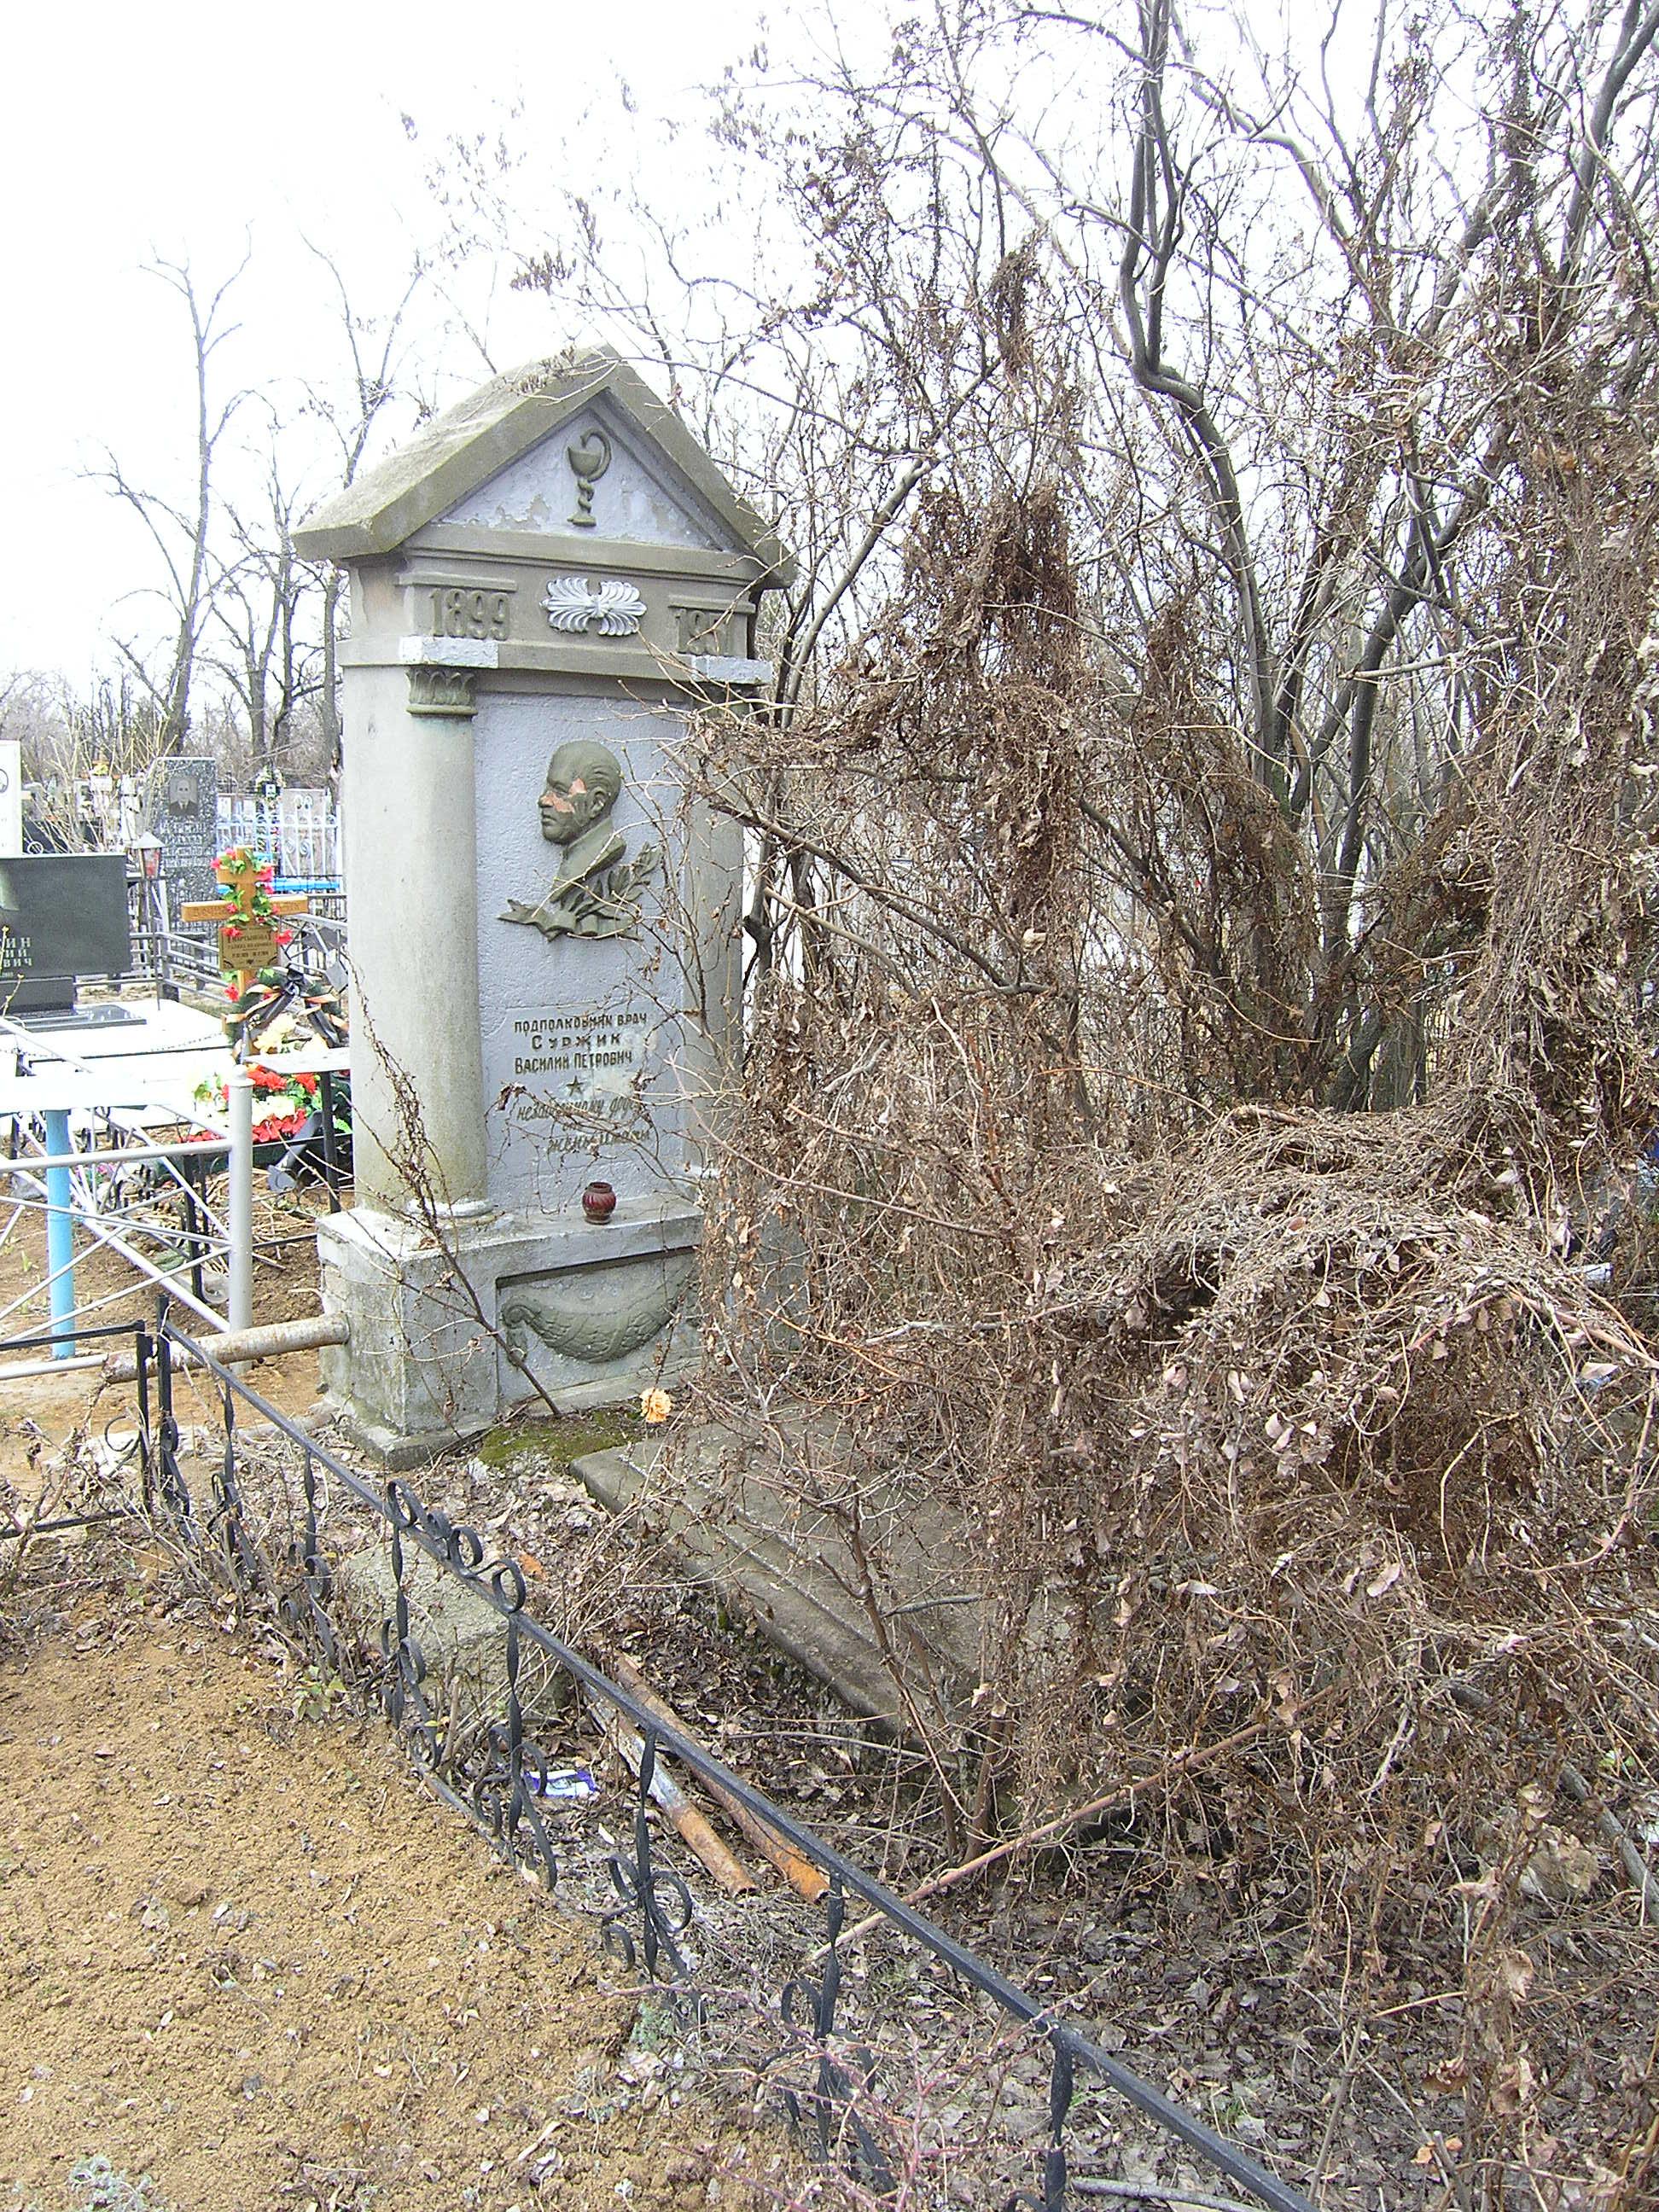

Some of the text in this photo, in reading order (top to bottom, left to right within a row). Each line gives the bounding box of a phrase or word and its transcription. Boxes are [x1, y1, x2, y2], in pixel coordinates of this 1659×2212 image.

[428, 588, 509, 641] 1899
[514, 1012, 647, 1035] ПОДПОЛКОВНИК ВРАЧ
[574, 1051, 633, 1068] ПЕТРОВИЧ
